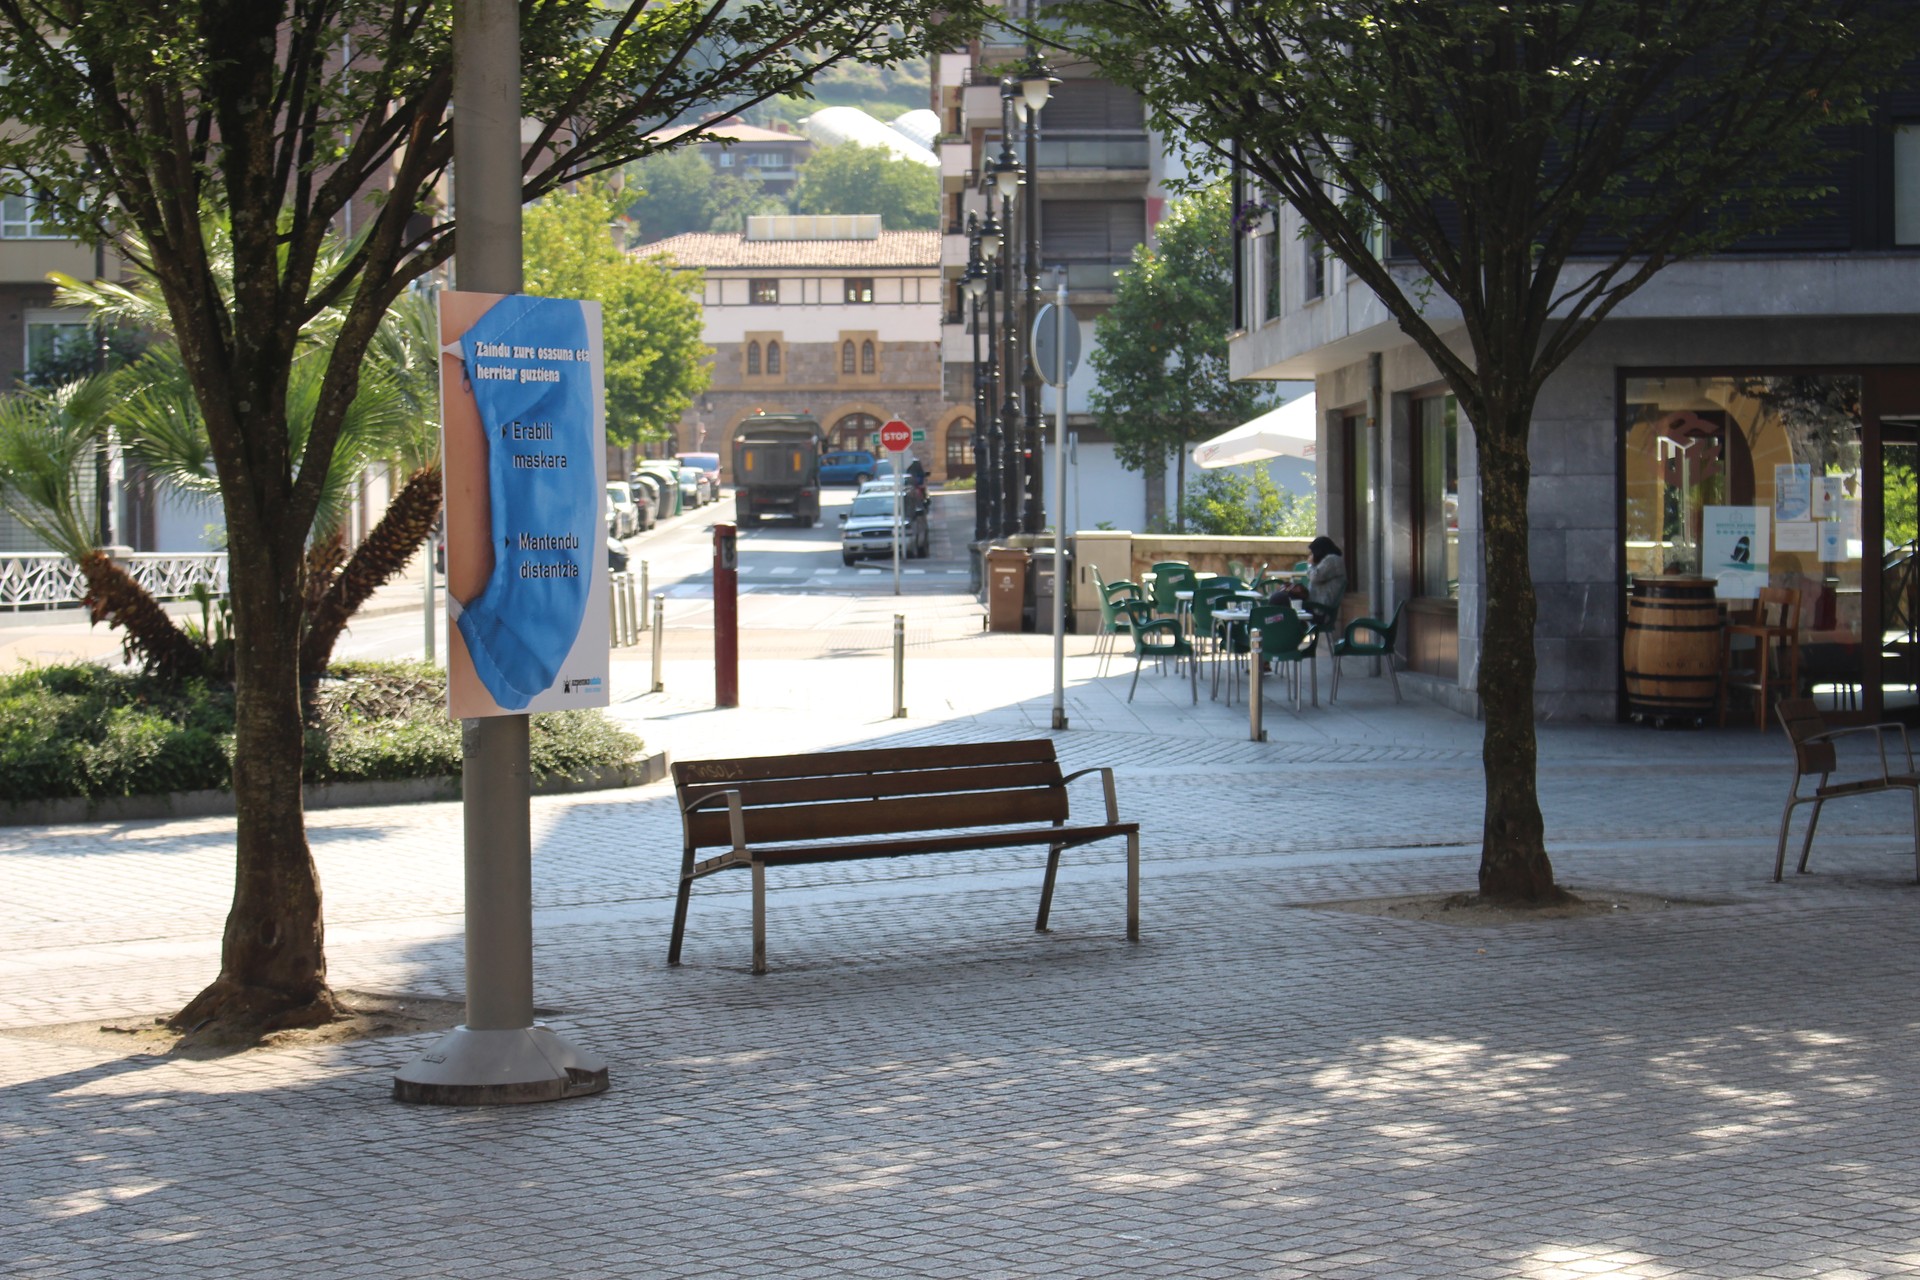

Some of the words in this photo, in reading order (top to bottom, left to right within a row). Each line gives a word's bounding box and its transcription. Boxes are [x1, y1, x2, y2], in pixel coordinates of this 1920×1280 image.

[475, 341, 510, 358] Zaindu
[512, 346, 535, 359] zure
[537, 347, 574, 361] osasuna
[575, 349, 590, 362] eta
[475, 363, 518, 381] herritar
[519, 367, 560, 384] guztiena
[512, 421, 553, 440] Erabili
[883, 432, 909, 441] STOP
[512, 450, 568, 469] maskara
[518, 532, 579, 551] Mantendu
[520, 560, 579, 579] distantzia
